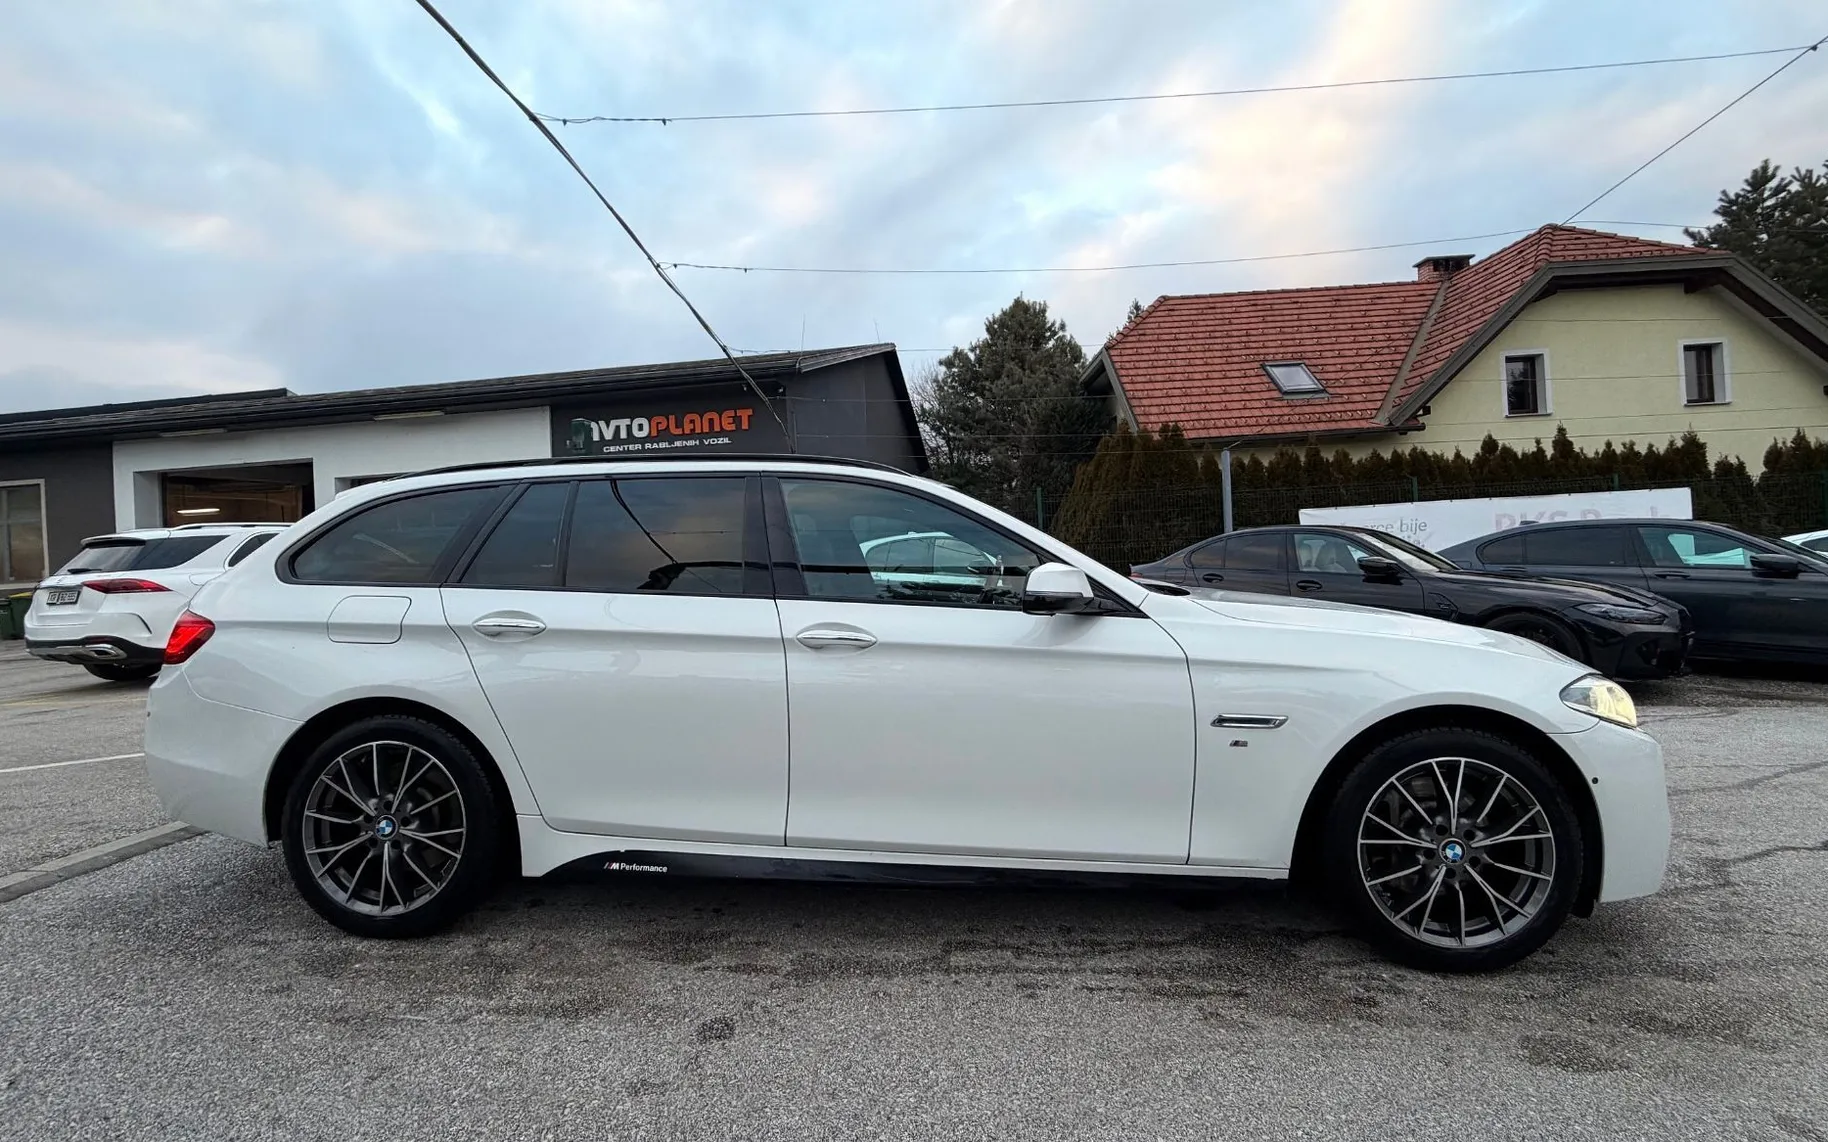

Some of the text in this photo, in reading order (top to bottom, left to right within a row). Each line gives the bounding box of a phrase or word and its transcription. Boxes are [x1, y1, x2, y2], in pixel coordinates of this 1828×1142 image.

[603, 436, 732, 453] CENTER RABLJENIH VOZIL
[1399, 516, 1428, 535] bije
[620, 862, 668, 873] Performance
